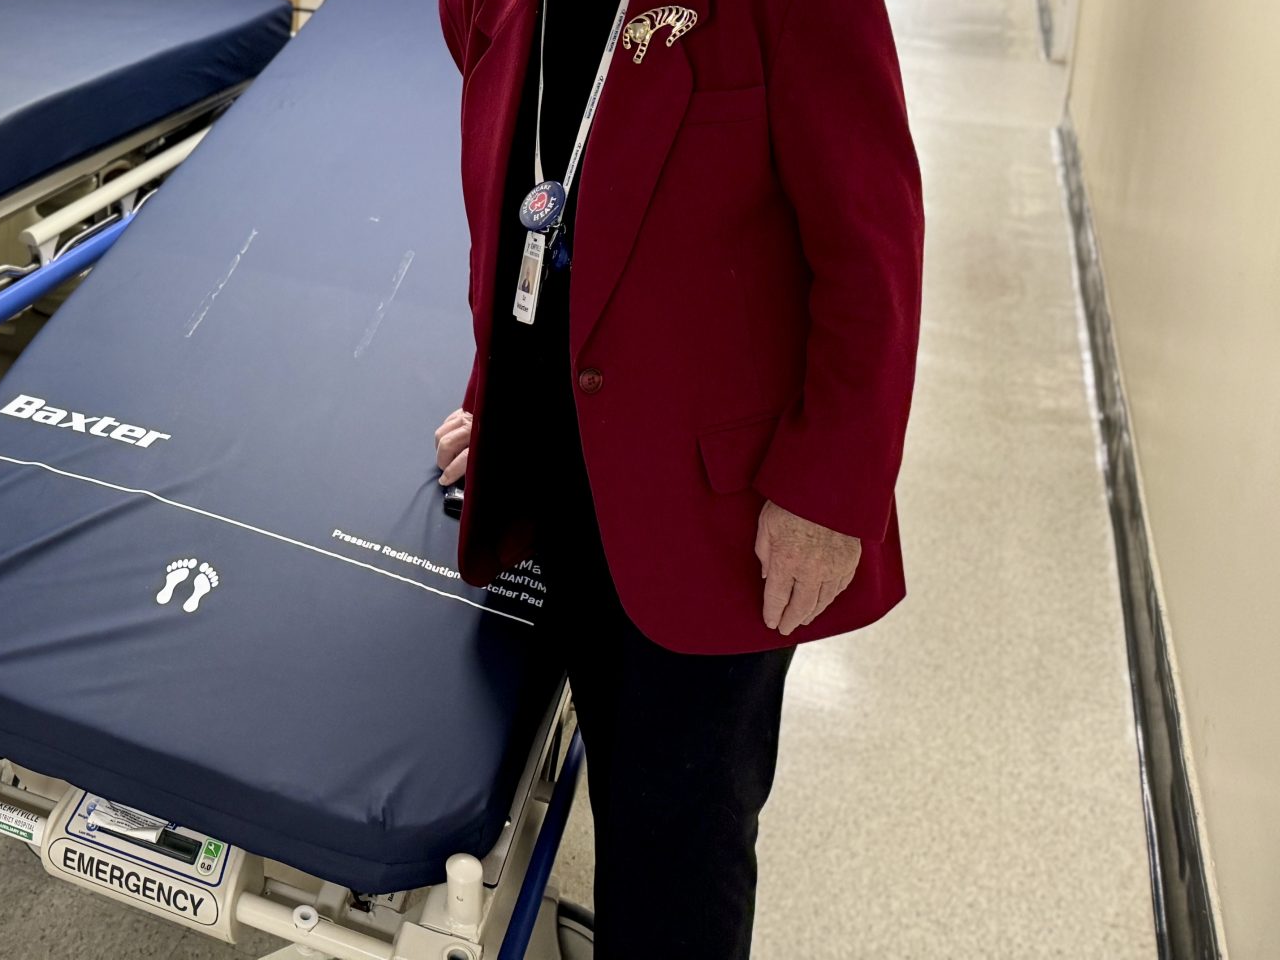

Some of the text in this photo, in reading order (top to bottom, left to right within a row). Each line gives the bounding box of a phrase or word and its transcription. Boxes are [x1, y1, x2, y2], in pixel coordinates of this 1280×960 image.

[533, 196, 557, 221] HEART
[0, 394, 171, 448] Baxter
[332, 529, 544, 608] Pressure Redistribution tcher Pad
[514, 559, 541, 575] Ma
[496, 571, 547, 594] UANTUM
[14, 819, 35, 832] HOSPITAL
[200, 862, 212, 871] 0.0
[63, 847, 204, 916] EMERGENCY
